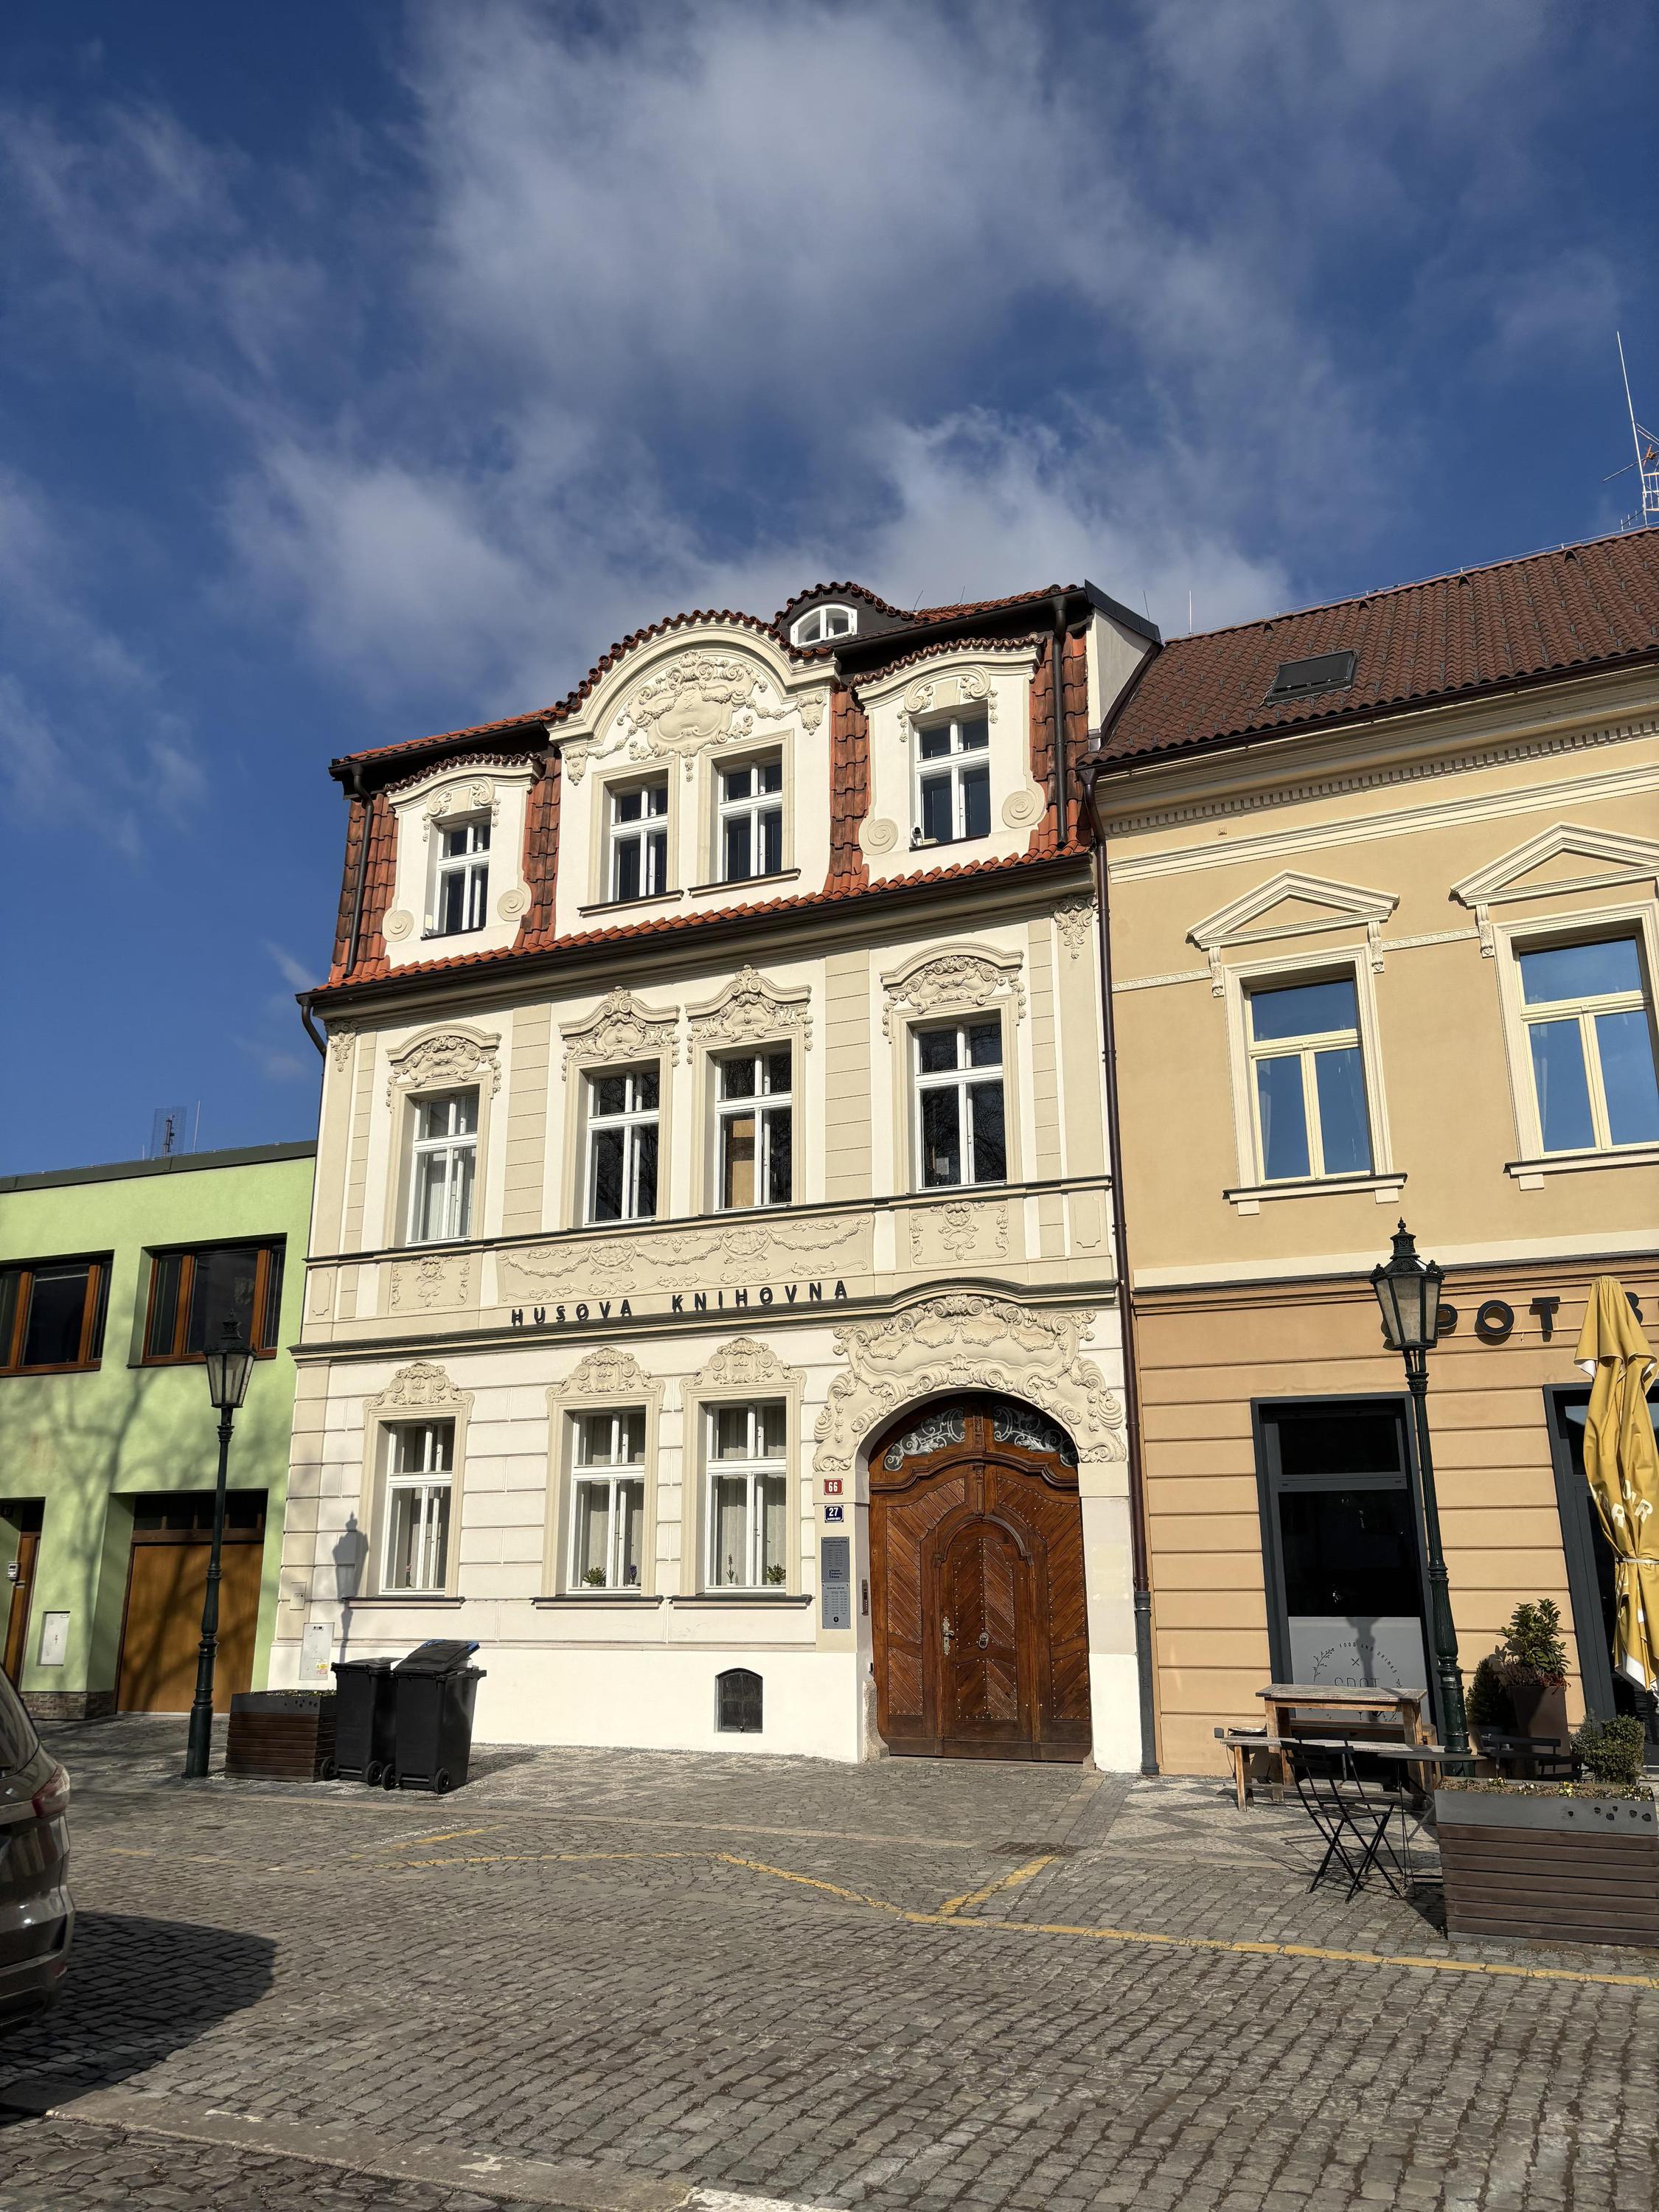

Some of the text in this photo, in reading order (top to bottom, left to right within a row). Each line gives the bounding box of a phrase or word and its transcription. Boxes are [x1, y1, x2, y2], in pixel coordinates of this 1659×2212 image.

[512, 1280, 847, 1326] HUSOVA KNIHOVNA
[828, 1481, 838, 1492] 66
[829, 1507, 838, 1517] 27
[1360, 1644, 1374, 1652] AND
[1377, 1652, 1397, 1674] DRINKS
